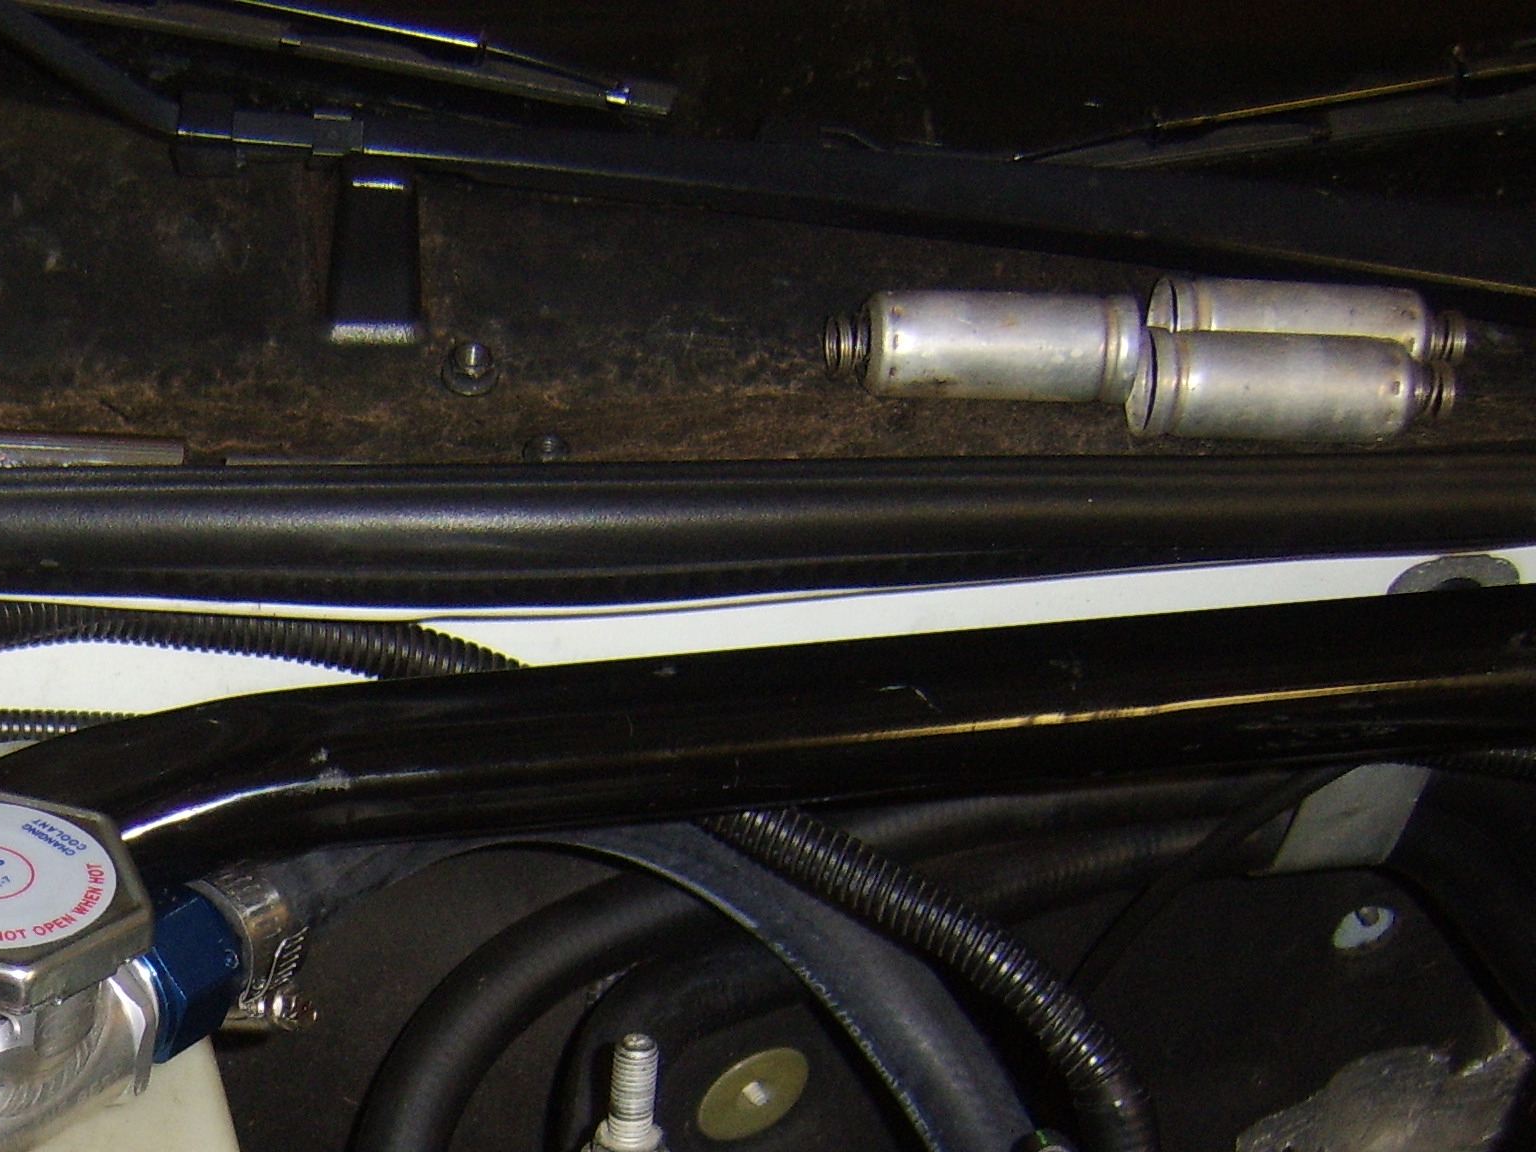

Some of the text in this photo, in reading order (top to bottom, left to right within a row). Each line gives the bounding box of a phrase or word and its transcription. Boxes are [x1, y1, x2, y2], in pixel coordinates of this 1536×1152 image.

[22, 824, 75, 856] CHANGING
[33, 819, 87, 850] COOLANT
[86, 863, 104, 884] HOT
[72, 886, 103, 915] WHEN
[33, 914, 77, 936] OPEN
